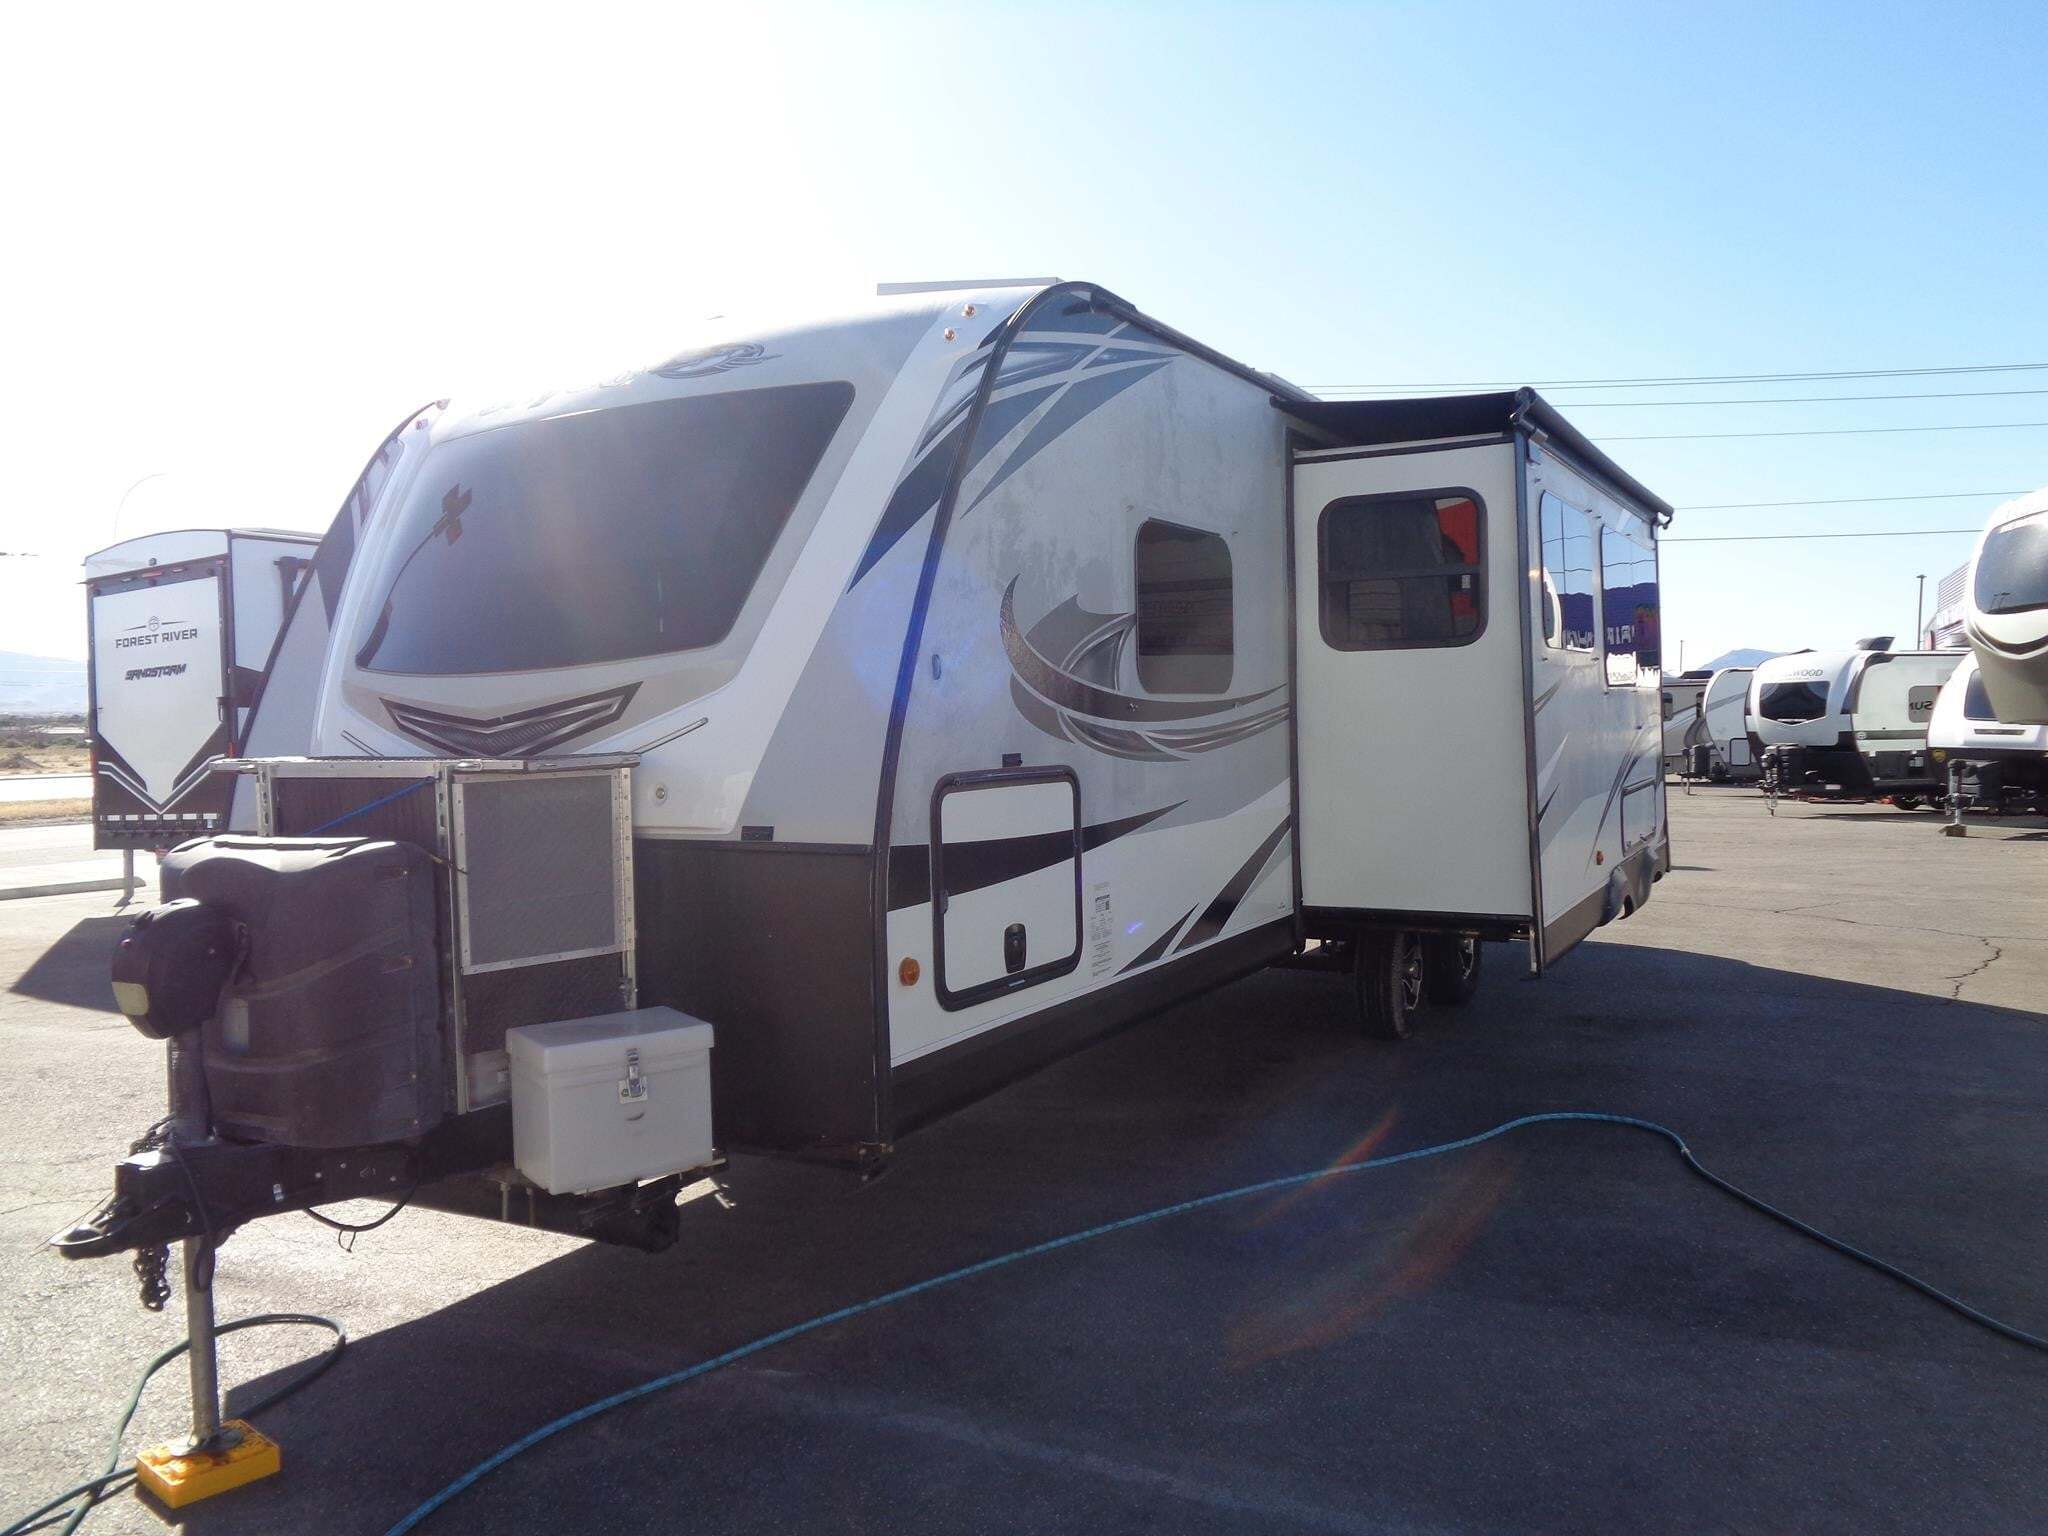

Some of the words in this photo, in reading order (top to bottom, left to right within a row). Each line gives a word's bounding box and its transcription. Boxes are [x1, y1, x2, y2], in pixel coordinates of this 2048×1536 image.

[115, 634, 159, 648] FOREST
[161, 628, 198, 642] RIVER
[125, 664, 187, 680] SANDSTORM
